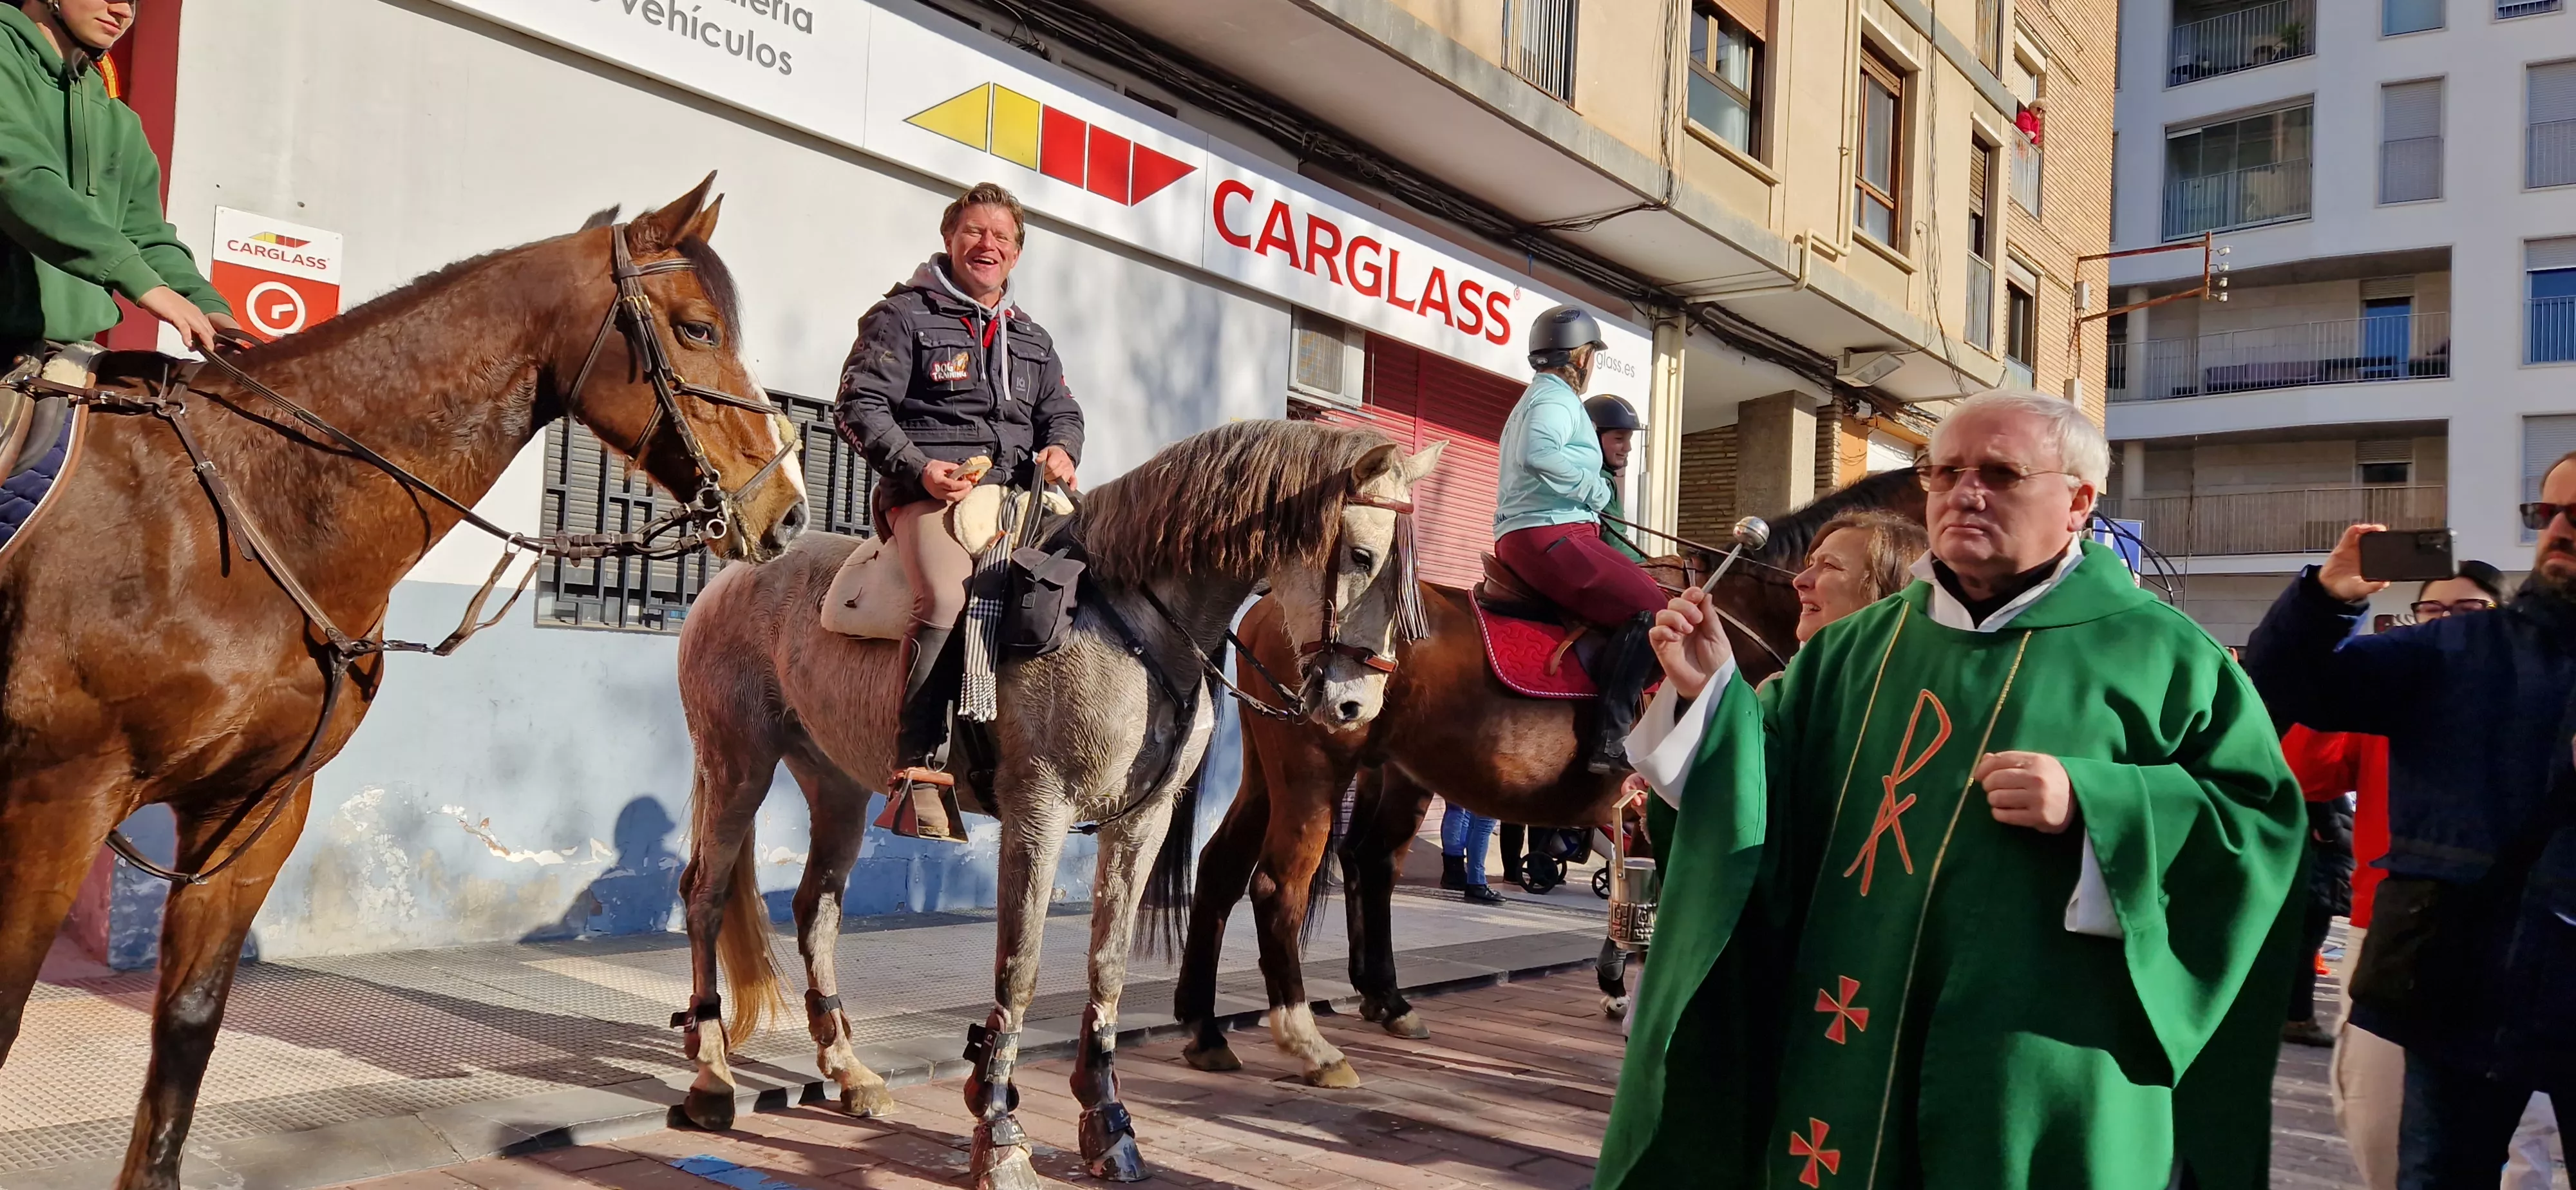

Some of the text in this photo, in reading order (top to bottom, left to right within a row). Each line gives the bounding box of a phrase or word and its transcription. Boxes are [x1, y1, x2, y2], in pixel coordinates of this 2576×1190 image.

[621, 0, 792, 75] vehículos
[227, 240, 327, 270] CARGLASS
[1213, 179, 1511, 346] CARGLASS
[932, 371, 967, 380] TRAINING
[934, 362, 954, 373] DOG
[1596, 351, 1635, 378] glass.es
